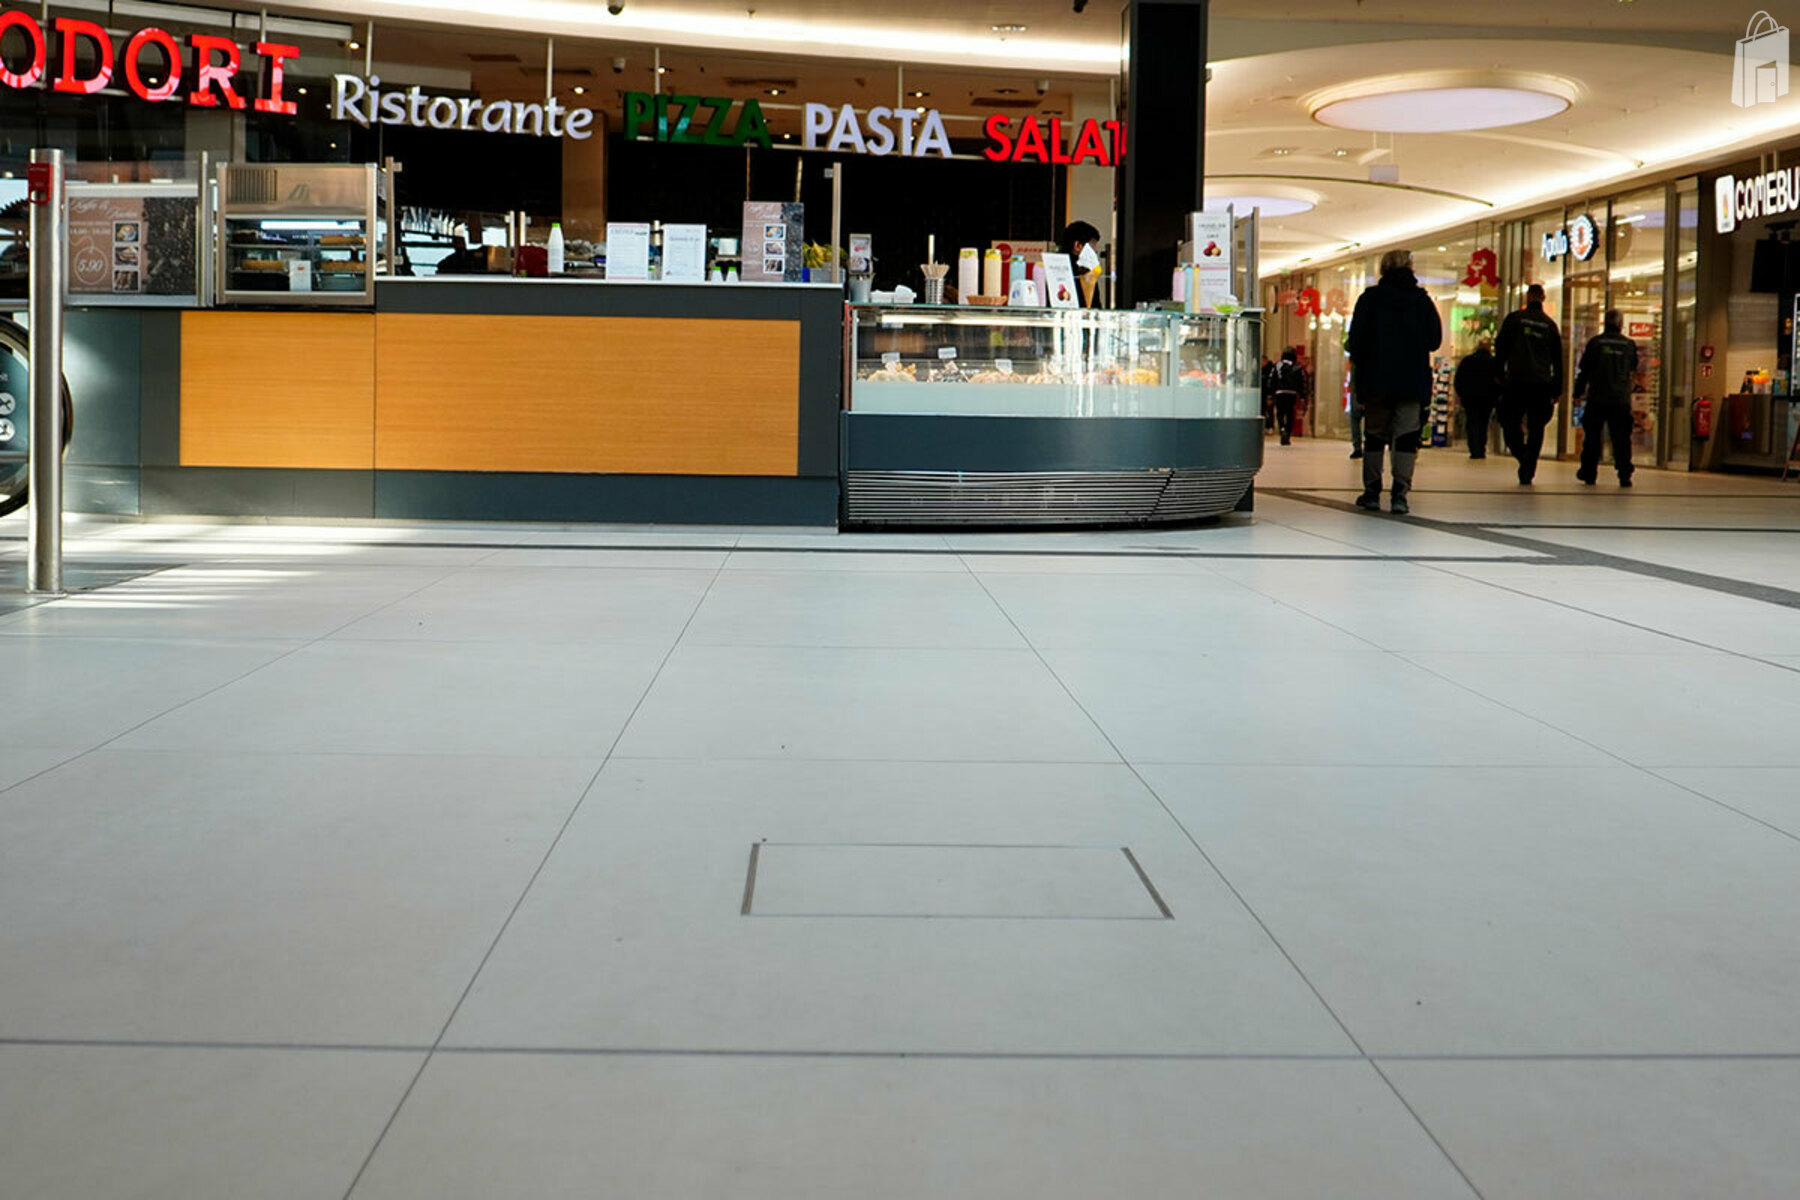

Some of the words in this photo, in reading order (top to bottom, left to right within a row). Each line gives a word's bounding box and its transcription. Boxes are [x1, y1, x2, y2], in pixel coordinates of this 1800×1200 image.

[333, 74, 593, 139] Ristorante
[623, 91, 772, 148] PIZZA
[804, 102, 952, 158] PASTA
[1735, 166, 1800, 221] COMEBU
